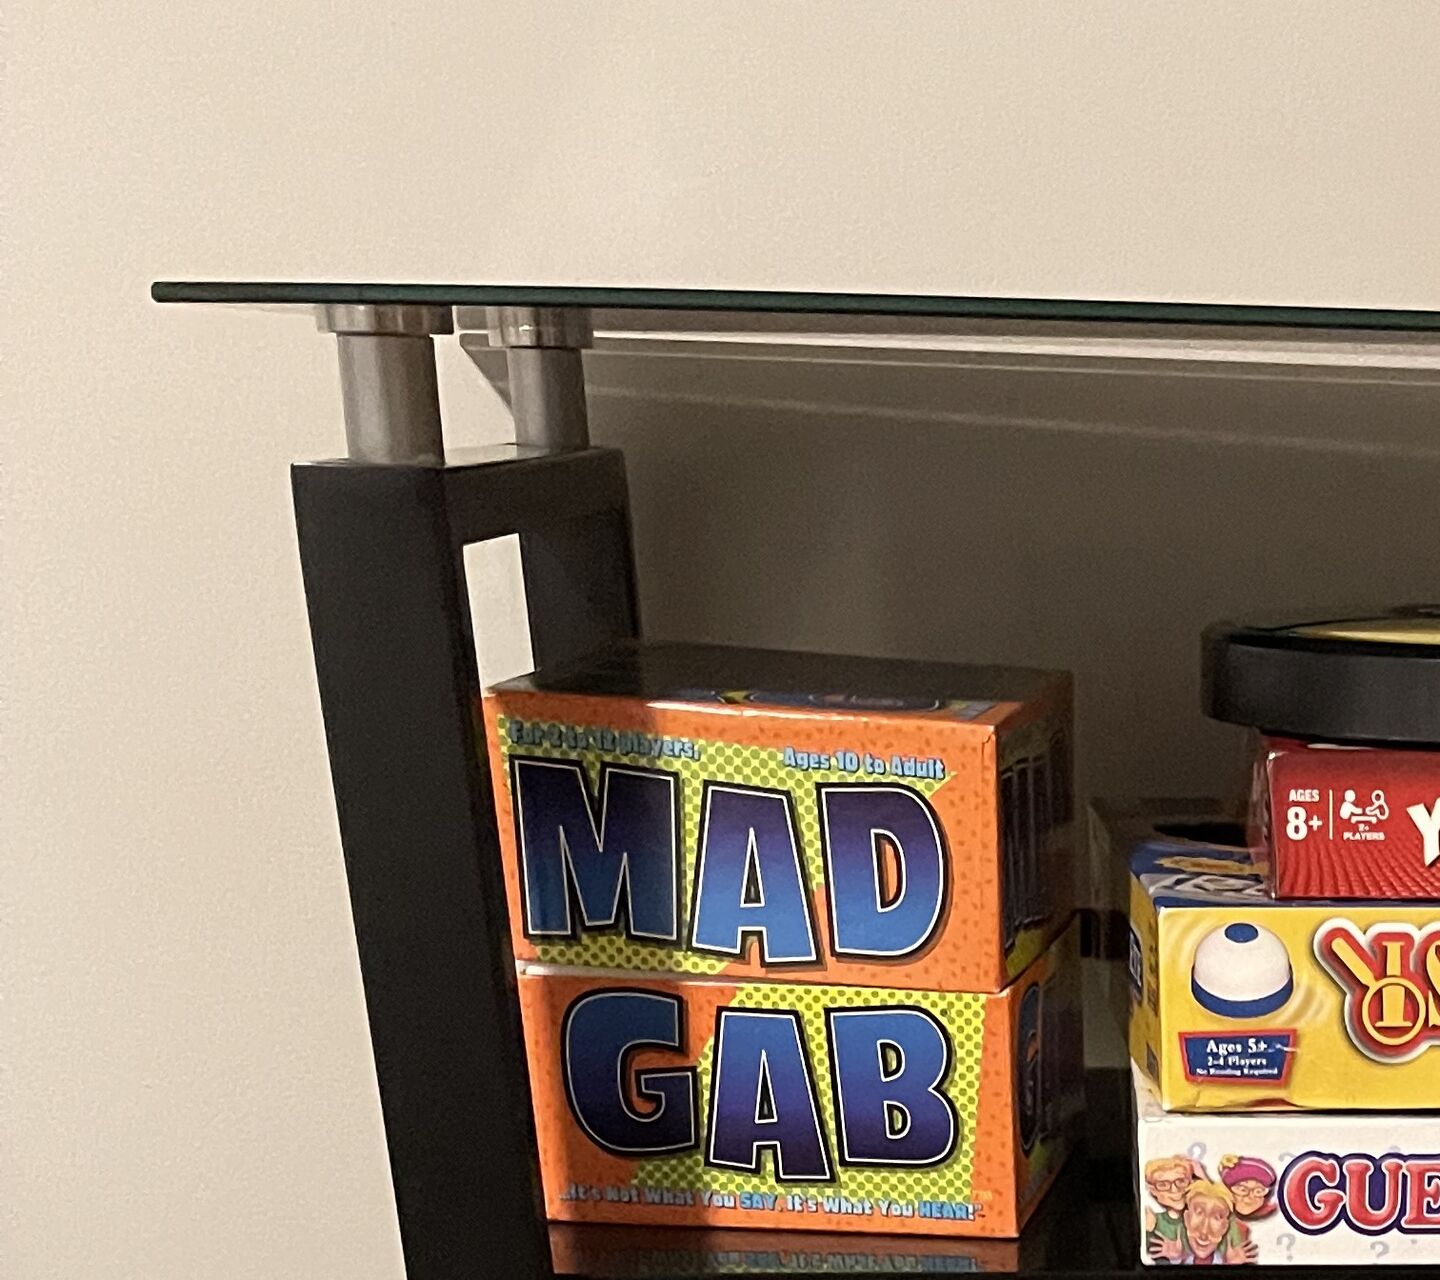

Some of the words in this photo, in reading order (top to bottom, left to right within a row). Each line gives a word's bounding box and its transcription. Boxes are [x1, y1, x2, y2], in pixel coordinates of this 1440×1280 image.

[783, 745, 831, 772] Ages
[834, 749, 859, 773] 10
[863, 754, 886, 776] to
[890, 754, 946, 781] Adult
[1288, 788, 1320, 803] AGES
[1286, 806, 1323, 841] 8+
[1343, 831, 1385, 841] PLAYERS
[508, 754, 952, 966] MAD
[1205, 1039, 1242, 1057] Ages
[1247, 1037, 1268, 1053] 5+
[1227, 1055, 1267, 1069] Players
[560, 986, 963, 1184] GAB
[605, 1185, 640, 1204] Not
[644, 1187, 695, 1207] What
[701, 1189, 736, 1209] You
[786, 1194, 818, 1213] It's
[822, 1196, 874, 1217] What
[878, 1199, 915, 1218] You
